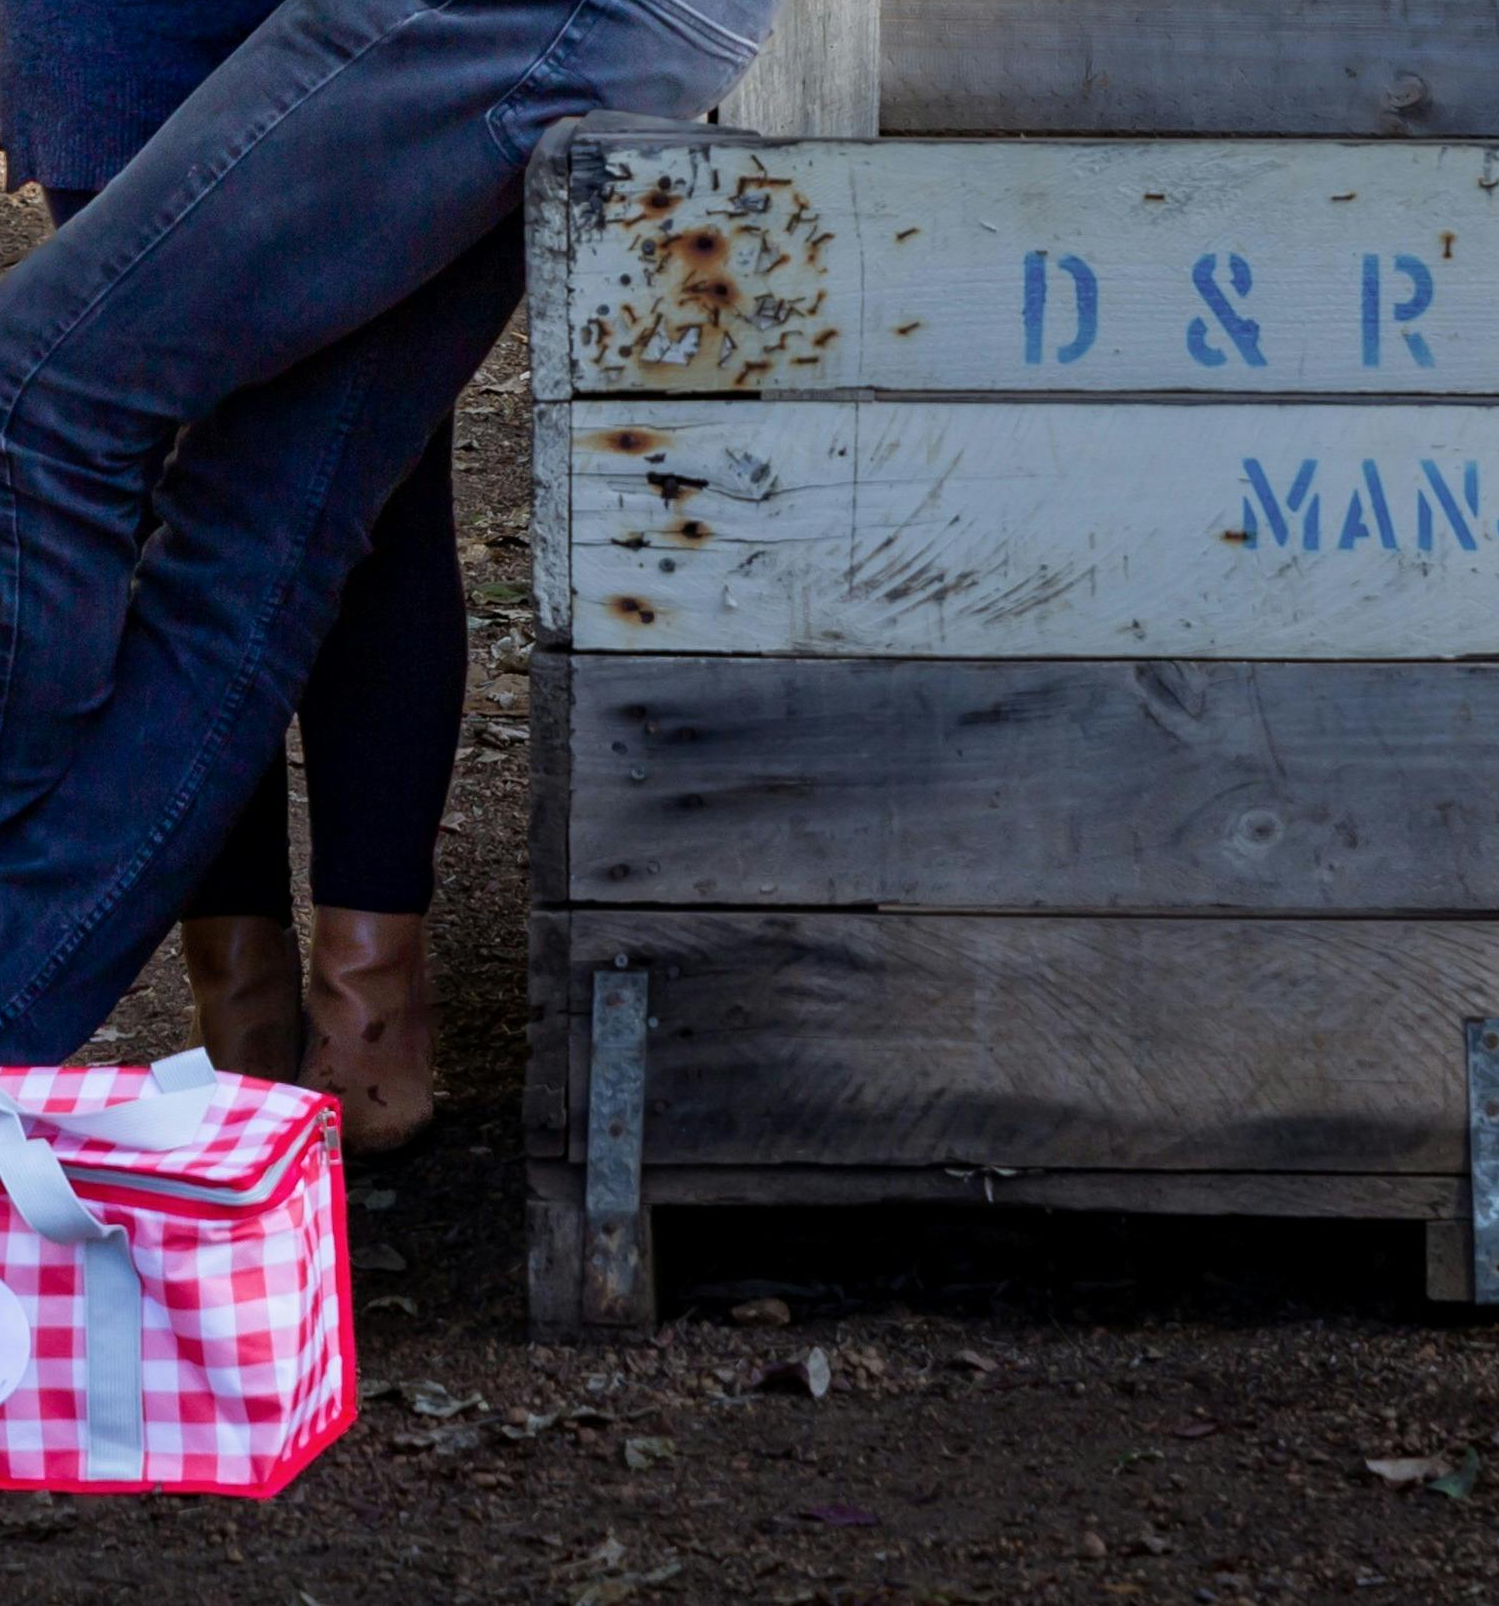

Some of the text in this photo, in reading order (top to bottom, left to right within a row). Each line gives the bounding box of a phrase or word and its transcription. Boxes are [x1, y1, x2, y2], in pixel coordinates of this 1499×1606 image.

[1022, 251, 1100, 367] D
[1184, 253, 1269, 369] &
[1360, 253, 1436, 369] R
